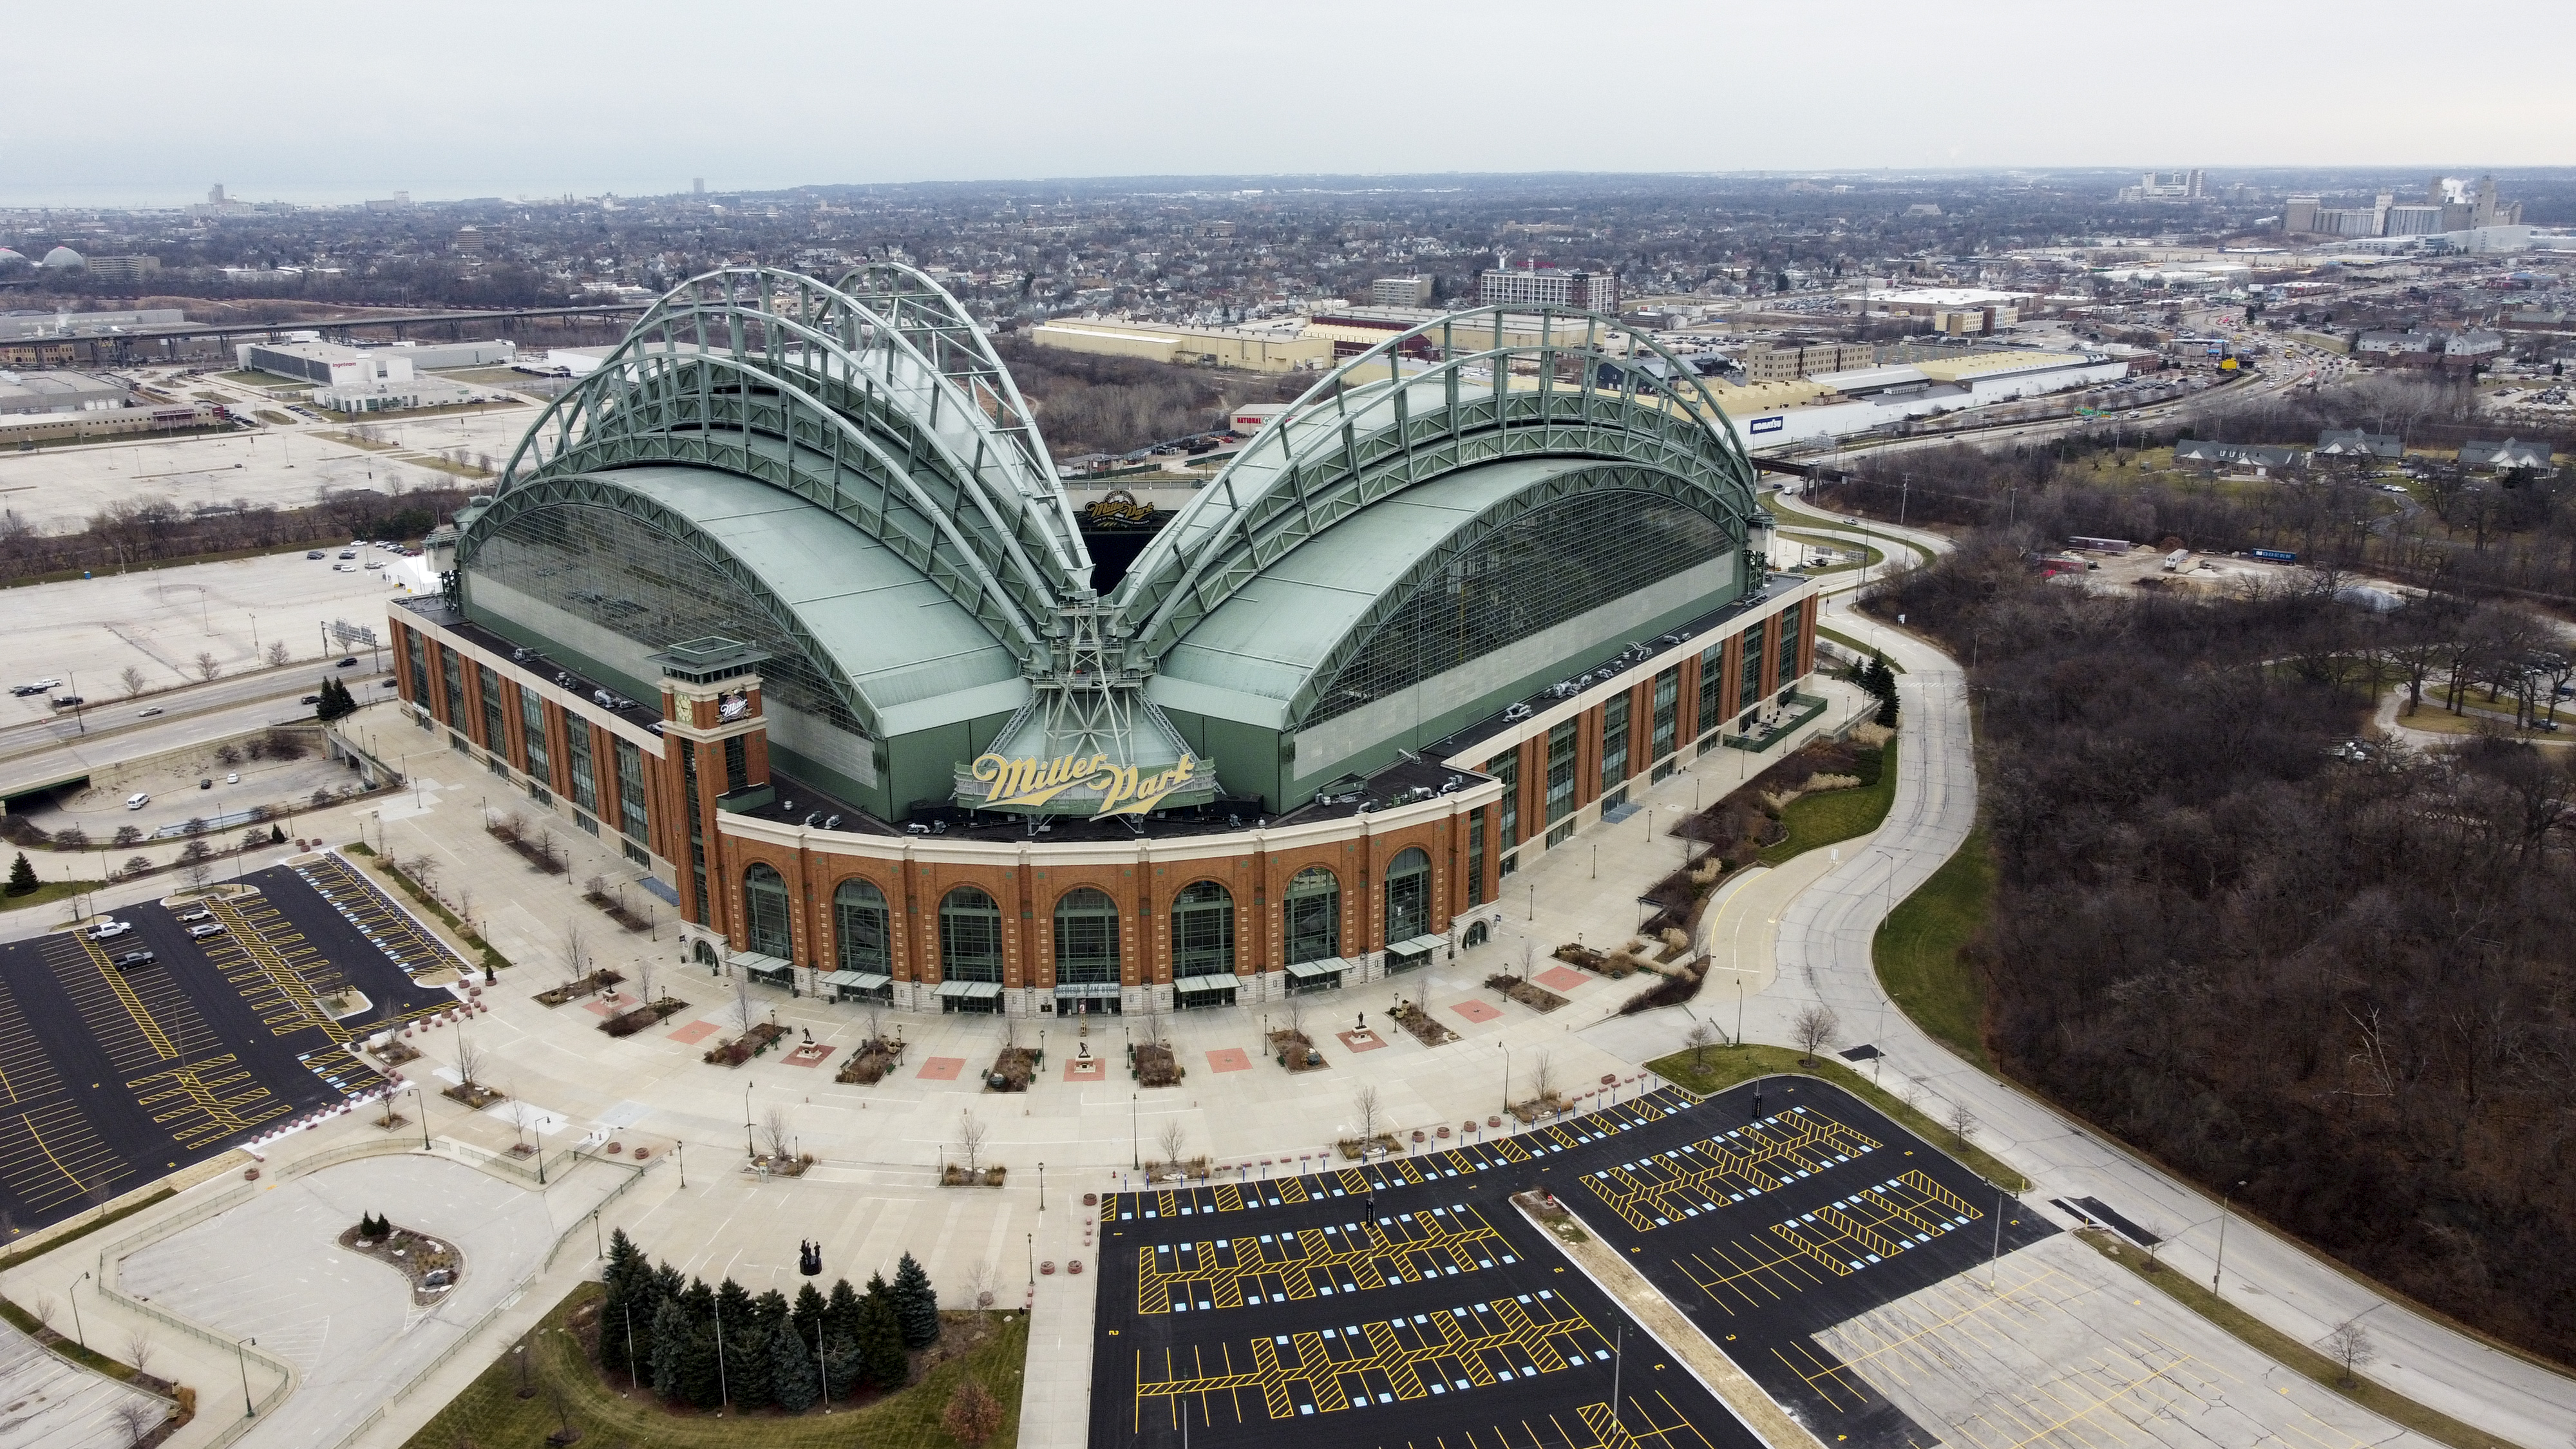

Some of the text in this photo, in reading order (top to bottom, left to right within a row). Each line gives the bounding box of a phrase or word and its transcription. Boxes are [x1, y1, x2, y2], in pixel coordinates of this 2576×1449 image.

[1752, 419, 1782, 431] KOMATSU
[1085, 500, 1154, 519] Miller Park
[720, 699, 748, 717] Miller
[972, 752, 1195, 815] Miller Park
